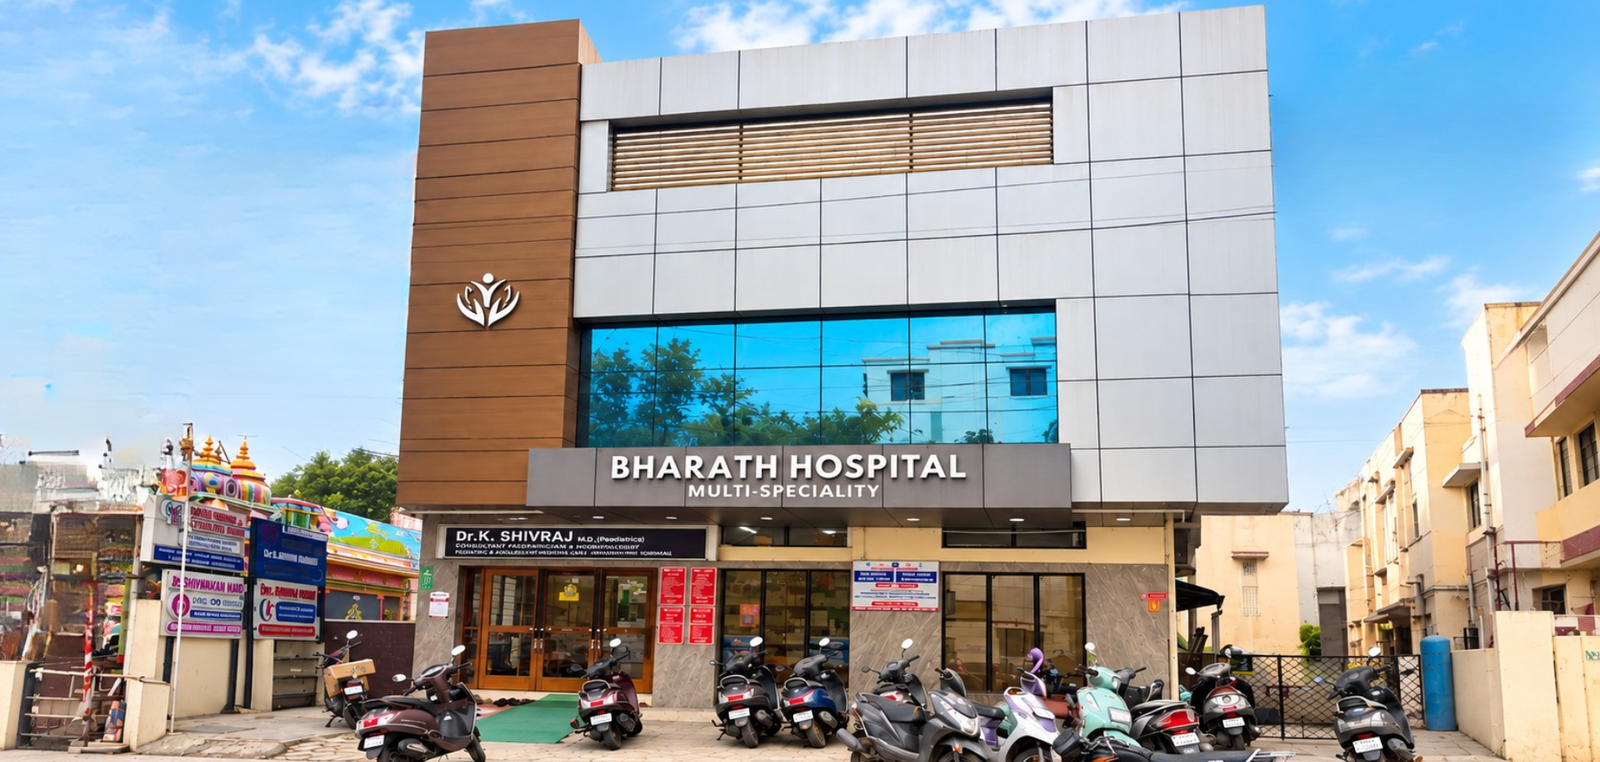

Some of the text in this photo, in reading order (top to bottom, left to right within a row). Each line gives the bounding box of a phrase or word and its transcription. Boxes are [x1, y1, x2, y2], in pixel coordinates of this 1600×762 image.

[611, 453, 967, 479] BHARATH HOSPITAL
[688, 484, 880, 498] MULTI-SPECIALITY
[500, 530, 573, 542] SHIVRAJ
